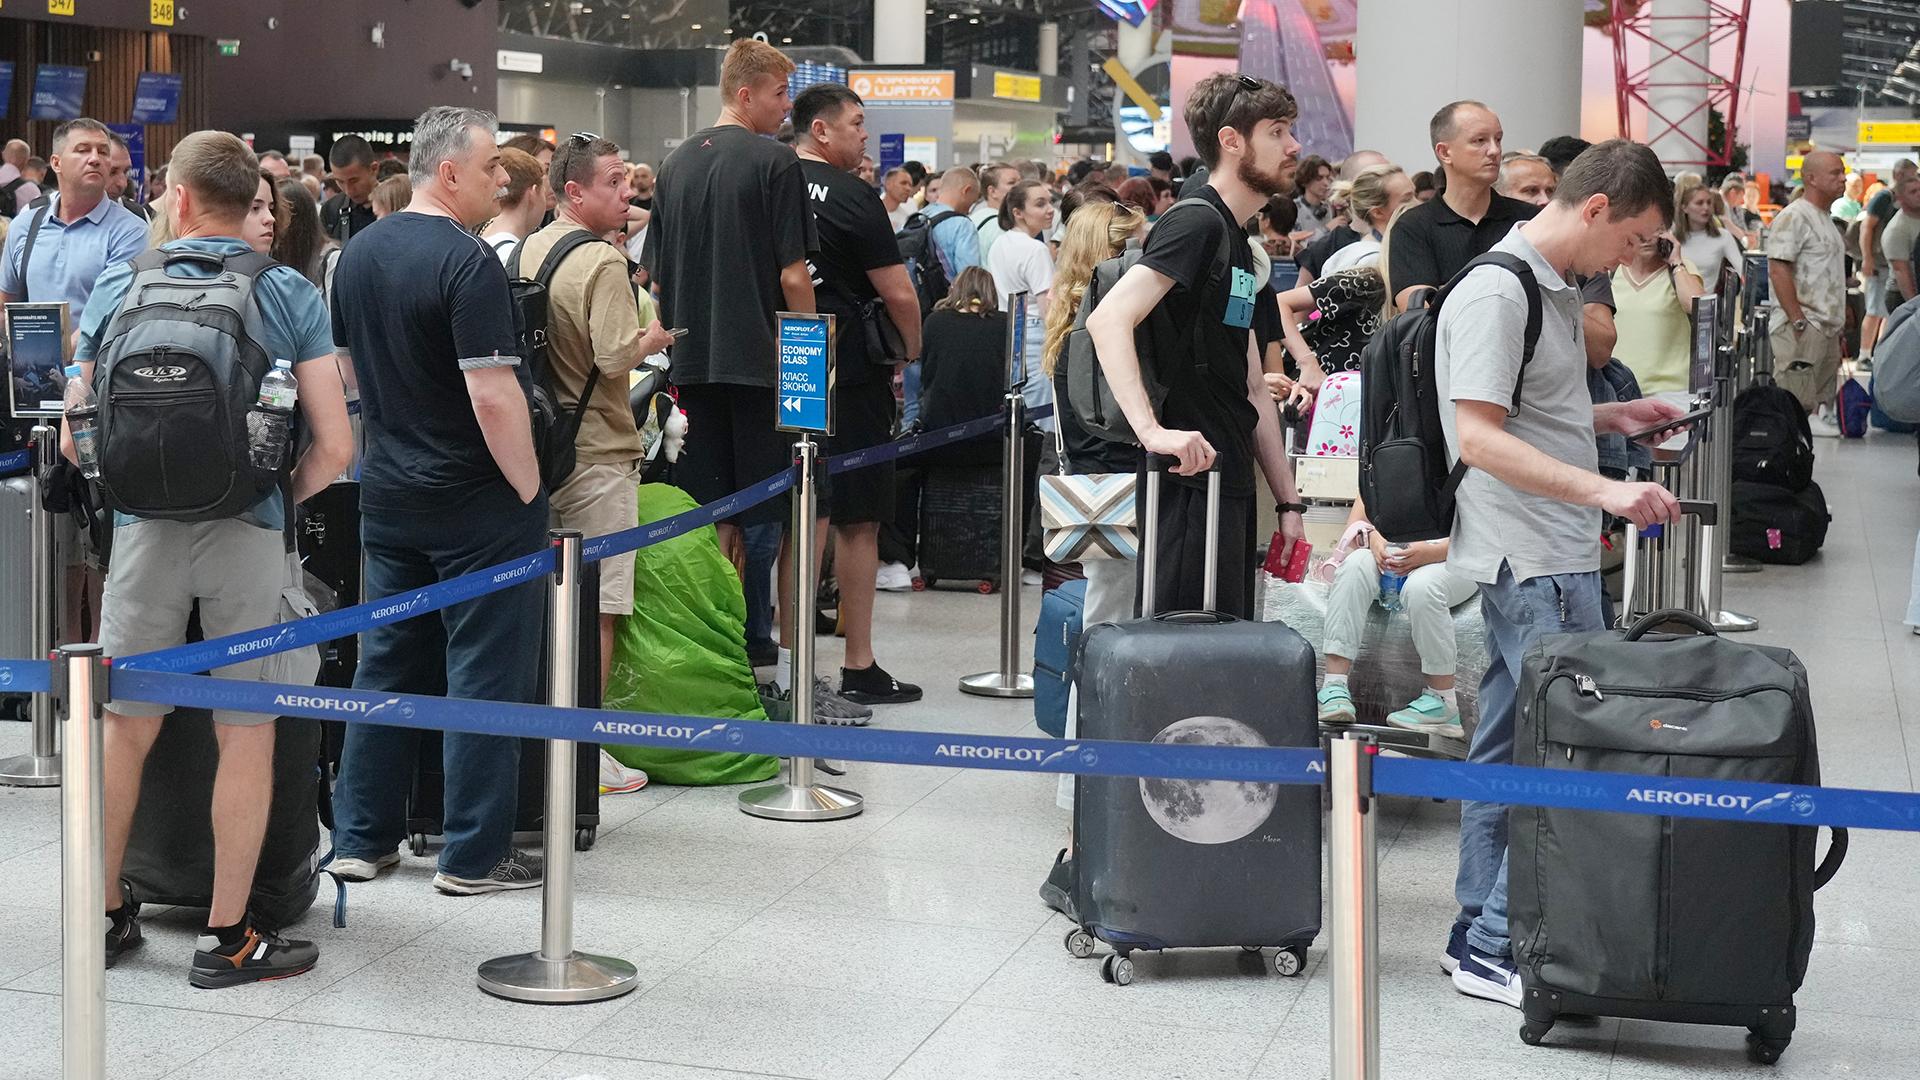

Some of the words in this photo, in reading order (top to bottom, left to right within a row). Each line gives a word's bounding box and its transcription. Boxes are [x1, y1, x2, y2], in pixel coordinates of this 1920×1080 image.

[51, 0, 71, 10] 347
[153, 4, 172, 20] 348
[782, 345, 823, 356] ECONOMY
[782, 355, 808, 365] CLASS
[782, 372, 809, 382] КЛАСС
[782, 382, 816, 392] ЭКОНОМ
[648, 525, 669, 538] AEROFLOT
[583, 545, 599, 556] OFLOT
[492, 566, 527, 584] AEROFLOT
[371, 601, 411, 620] AEROFLOT
[227, 636, 275, 656] AEROFLOT
[274, 694, 369, 712] AEROFLOT
[592, 721, 694, 739] AEROFLOT
[935, 744, 1045, 761] AEROFLOT
[1626, 788, 1752, 809] AEROFLOT
